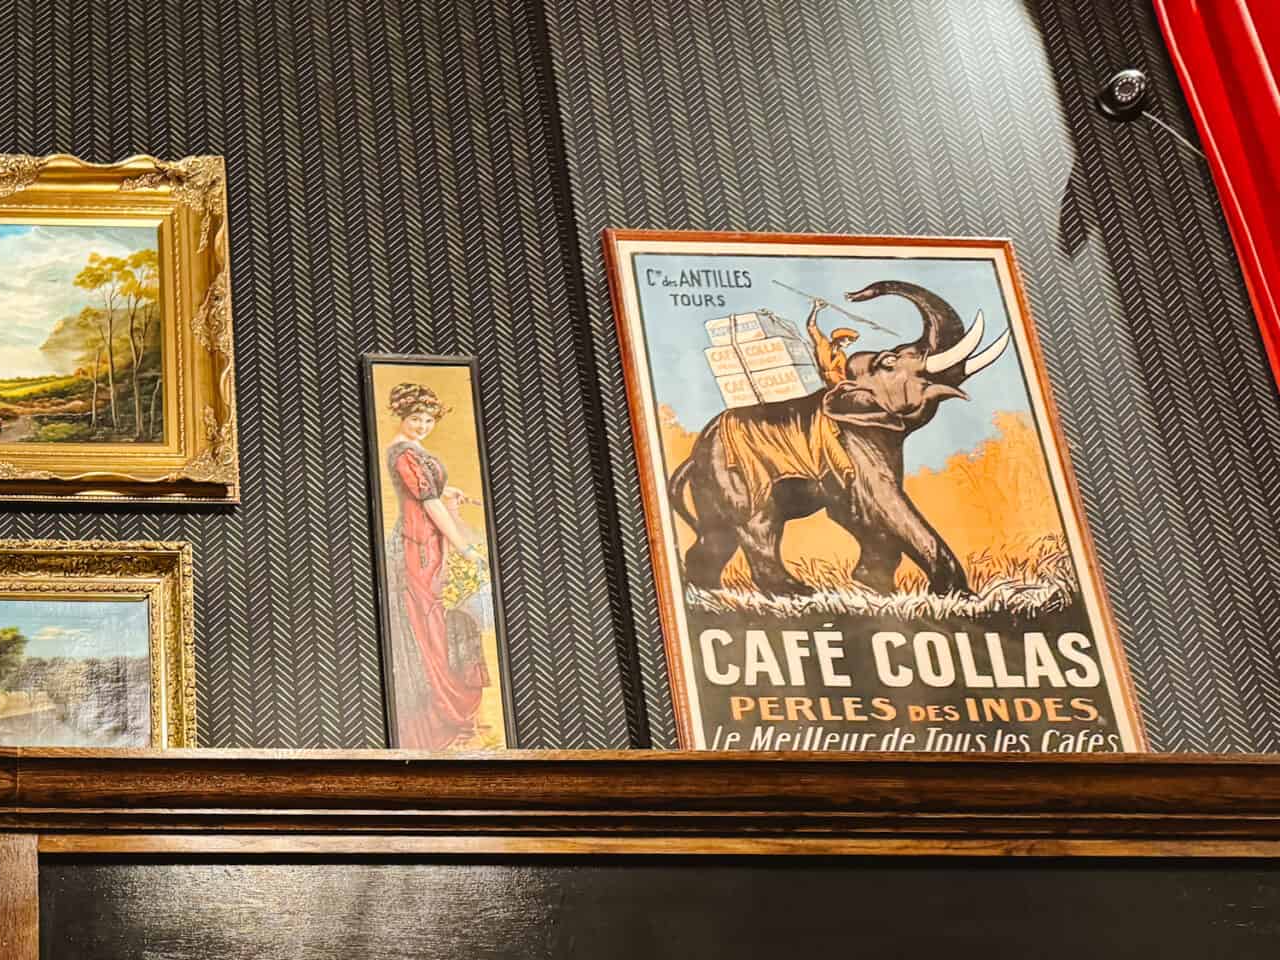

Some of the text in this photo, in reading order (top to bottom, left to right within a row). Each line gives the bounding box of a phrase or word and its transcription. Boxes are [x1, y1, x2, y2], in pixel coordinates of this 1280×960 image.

[680, 269, 752, 288] ANTILLES
[670, 294, 726, 307] TOURS
[699, 622, 1100, 688] CAFÉ COLLAS
[730, 696, 1099, 722] PERLES DES INDES
[750, 726, 876, 751] Meilleur
[880, 727, 916, 751] de
[922, 727, 987, 752] Tous
[994, 729, 1030, 752] les
